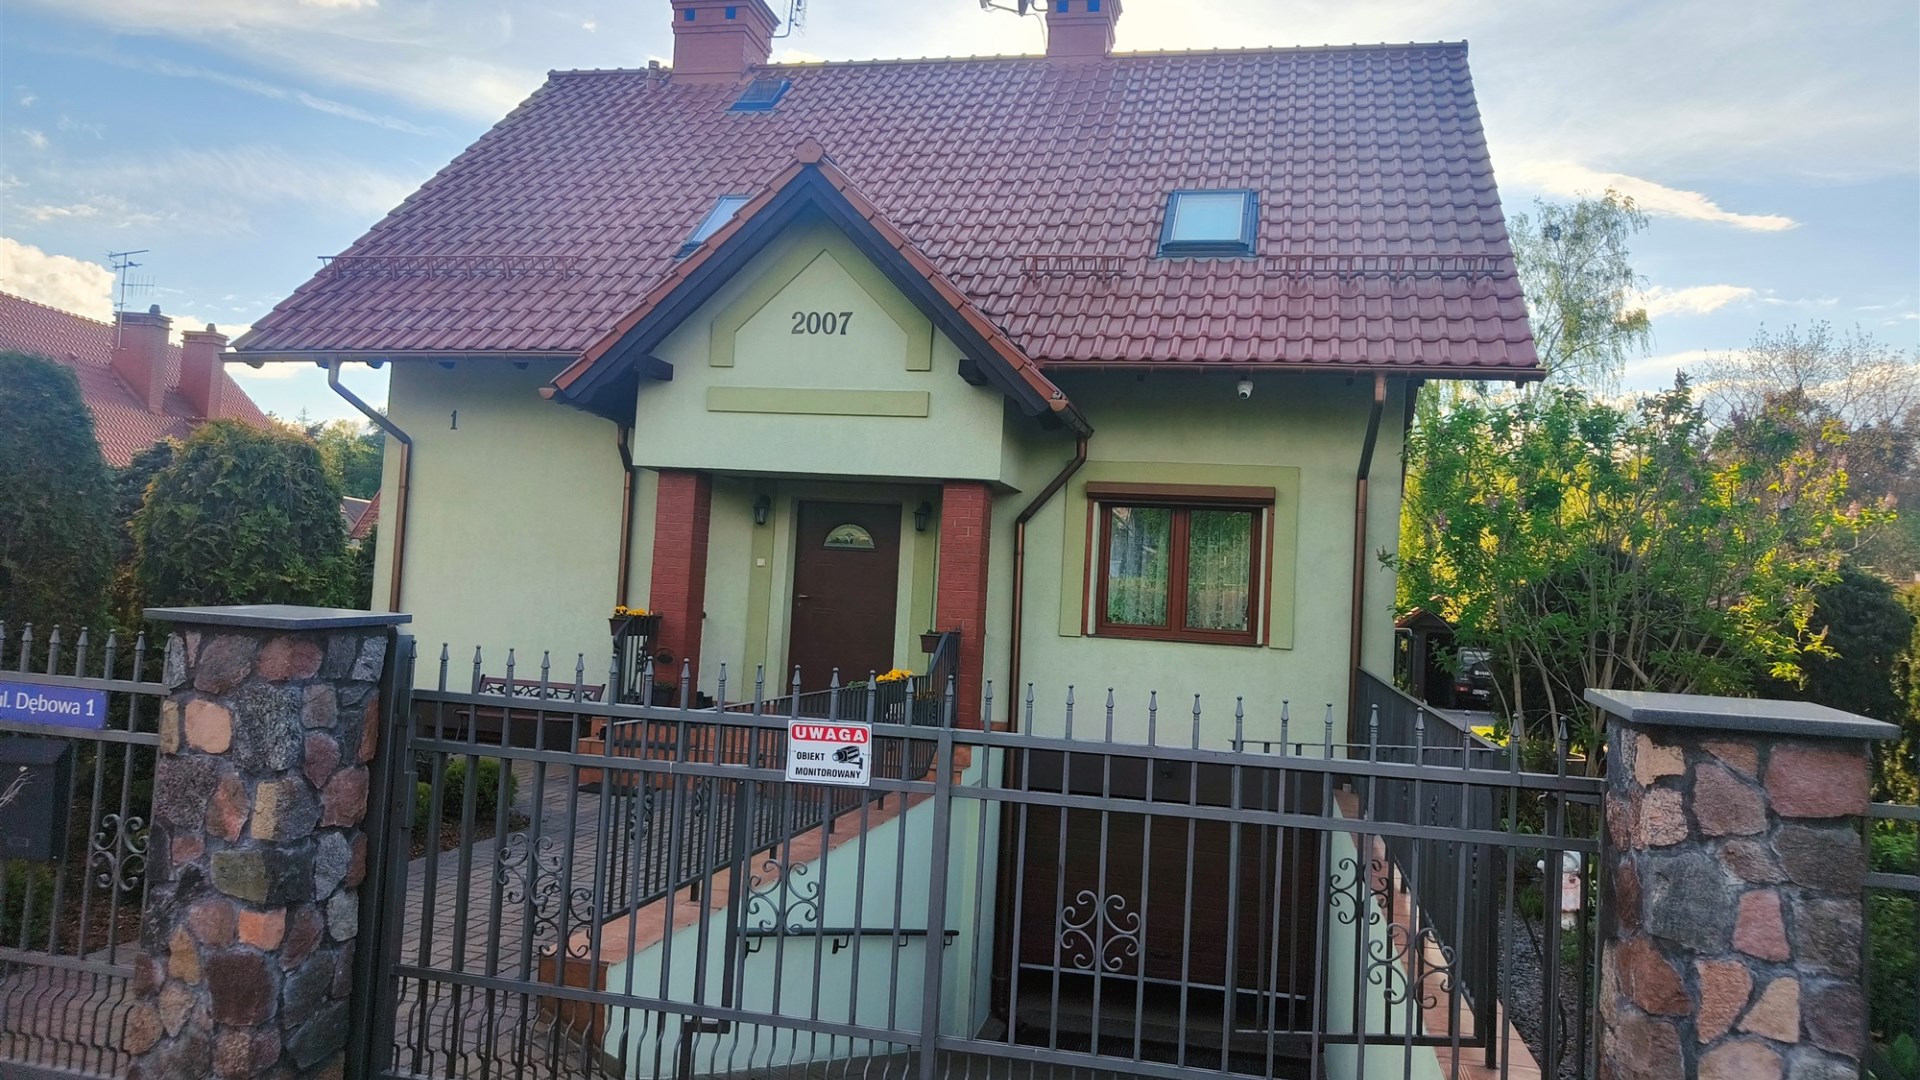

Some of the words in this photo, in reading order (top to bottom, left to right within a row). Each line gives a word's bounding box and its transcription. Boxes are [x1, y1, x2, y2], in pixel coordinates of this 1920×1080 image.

[791, 311, 853, 335] 2007
[450, 410, 458, 430] 1
[16, 692, 80, 714] Dębowa
[85, 699, 95, 716] 1
[795, 726, 865, 742] UWAGA
[796, 751, 825, 761] OBIEKT
[795, 767, 861, 779] MONITOROWANY
